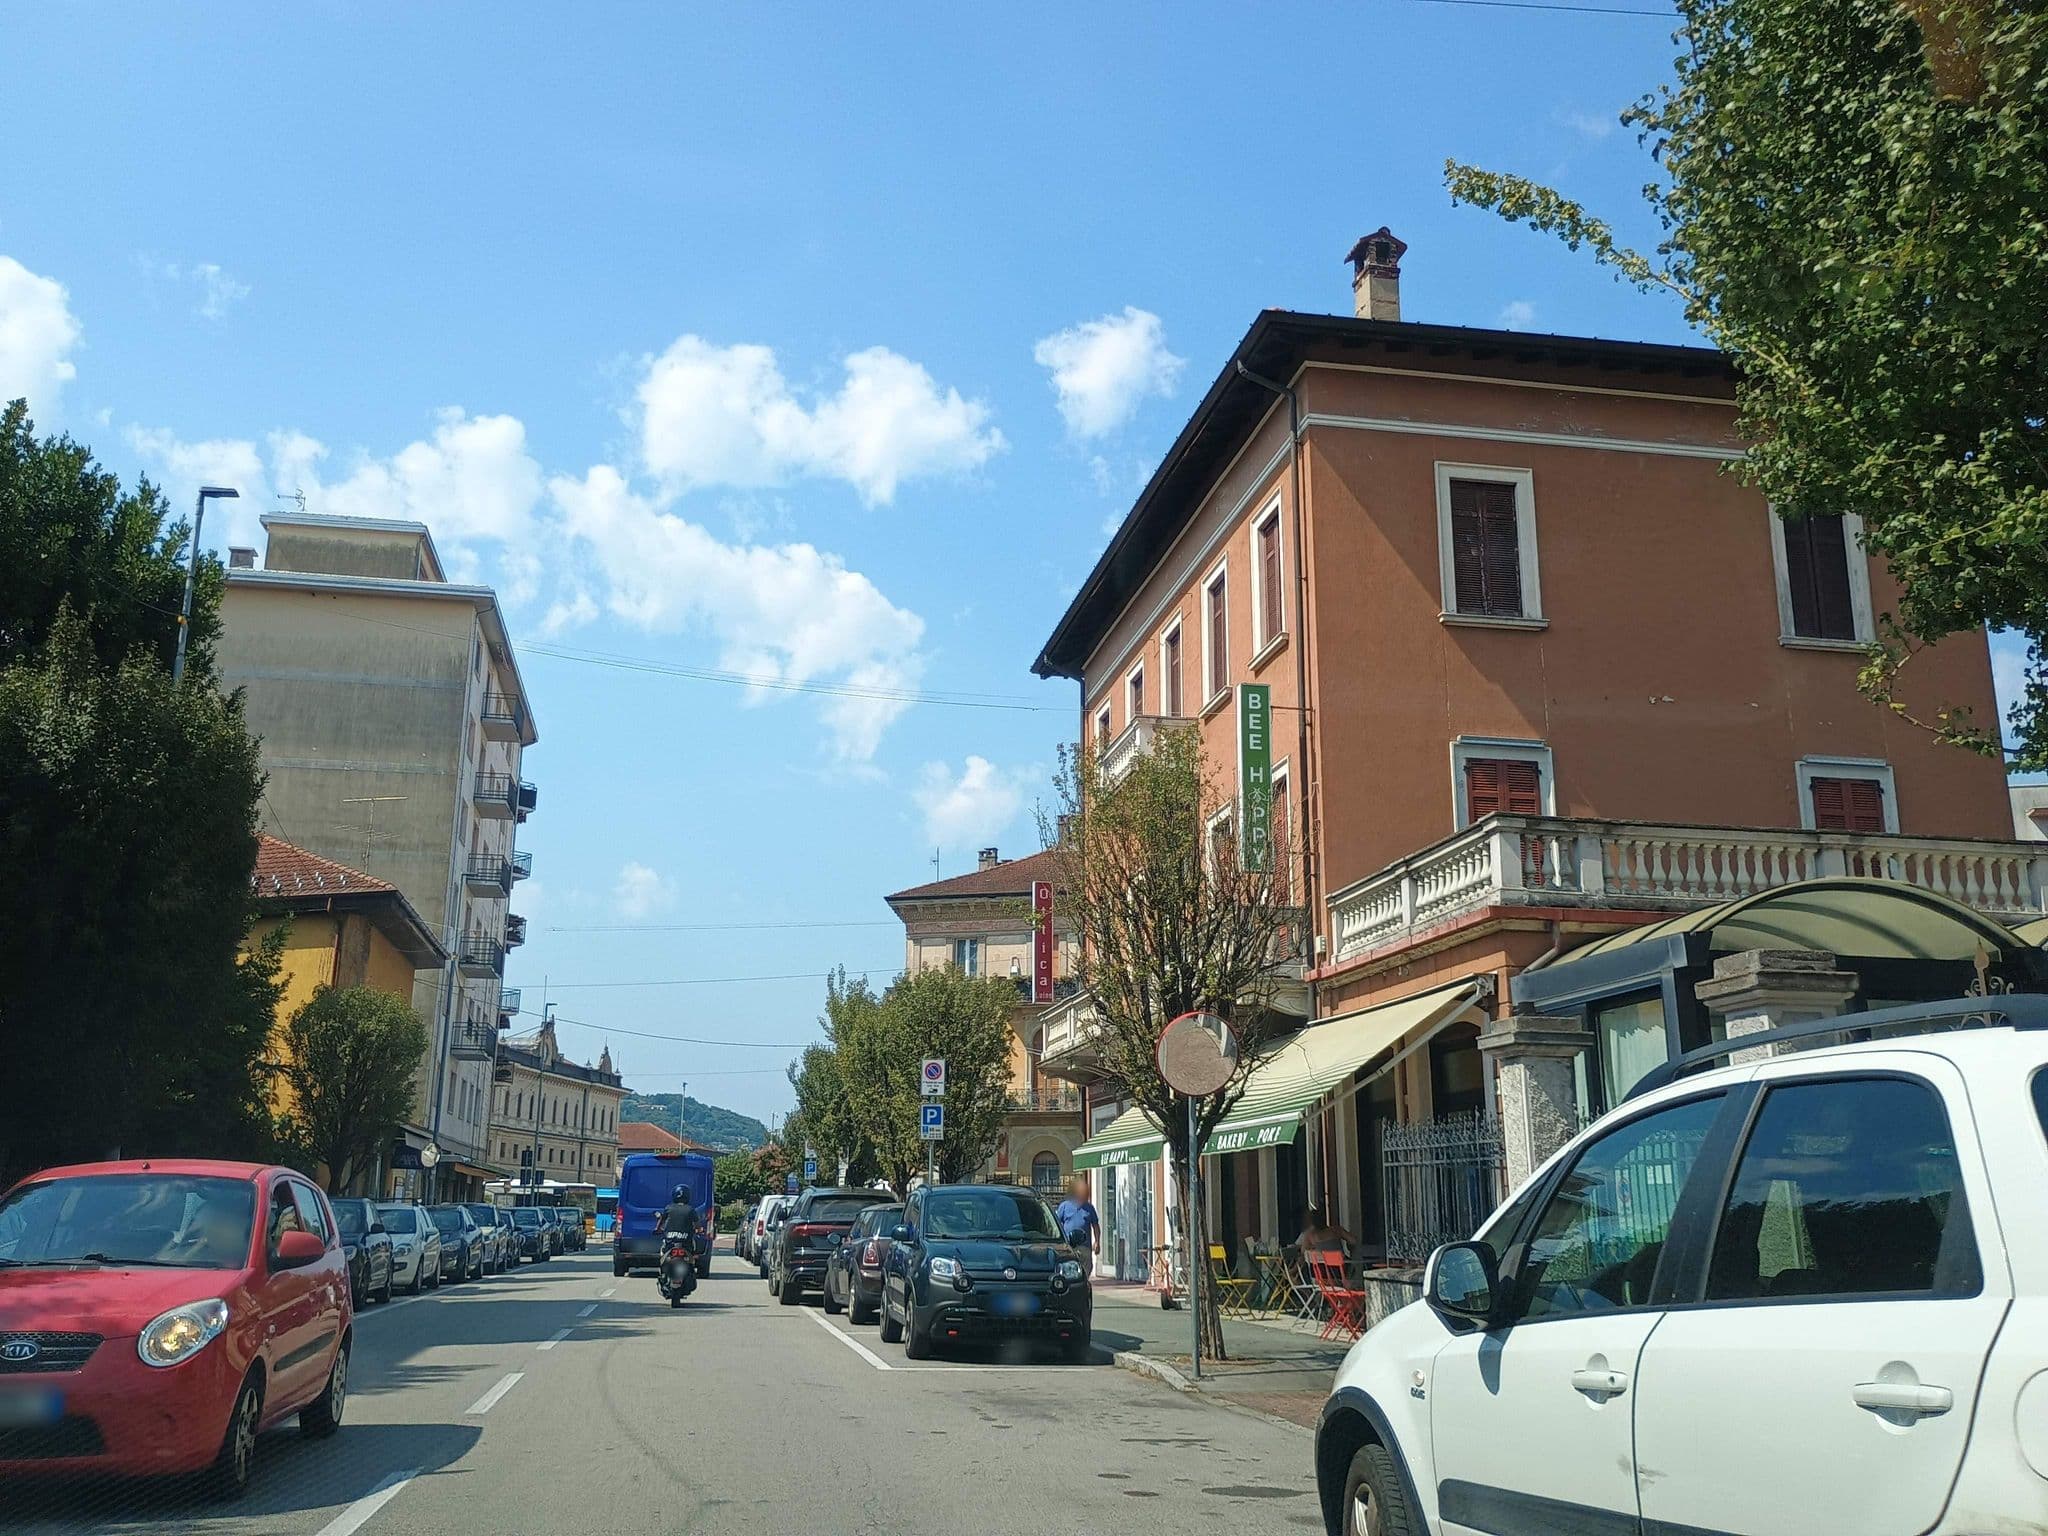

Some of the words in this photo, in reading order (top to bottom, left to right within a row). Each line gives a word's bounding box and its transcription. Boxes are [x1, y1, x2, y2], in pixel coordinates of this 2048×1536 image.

[1248, 693, 1262, 750] BEE
[926, 1109, 938, 1124] P
[1216, 1131, 1249, 1150] BAKERY
[1109, 1149, 1129, 1163] HAPPY
[807, 1163, 814, 1172] P
[5, 1346, 30, 1357] KIA
